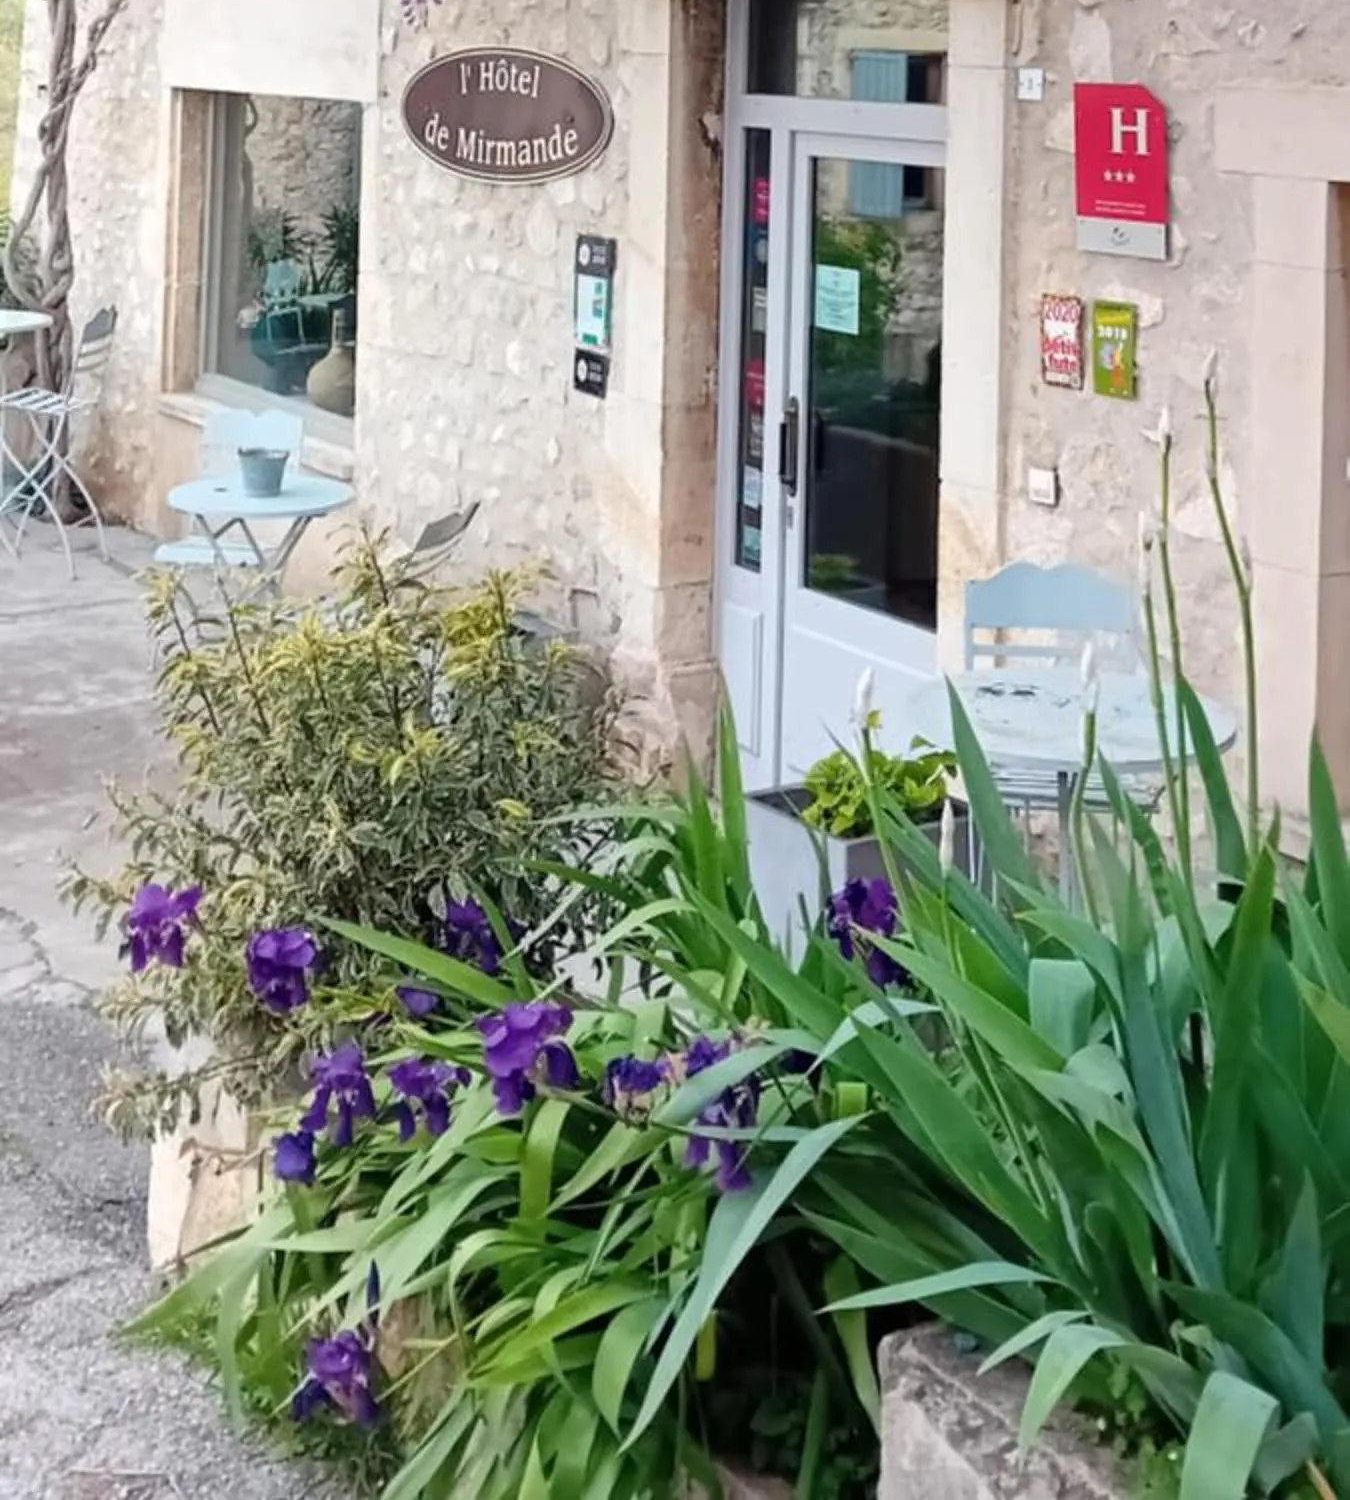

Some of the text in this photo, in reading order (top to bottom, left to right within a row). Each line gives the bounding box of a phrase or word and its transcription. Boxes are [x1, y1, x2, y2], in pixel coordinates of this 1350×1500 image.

[479, 59, 540, 98] Hôtel
[424, 113, 578, 167] de Mirmande
[1110, 107, 1150, 155] H
